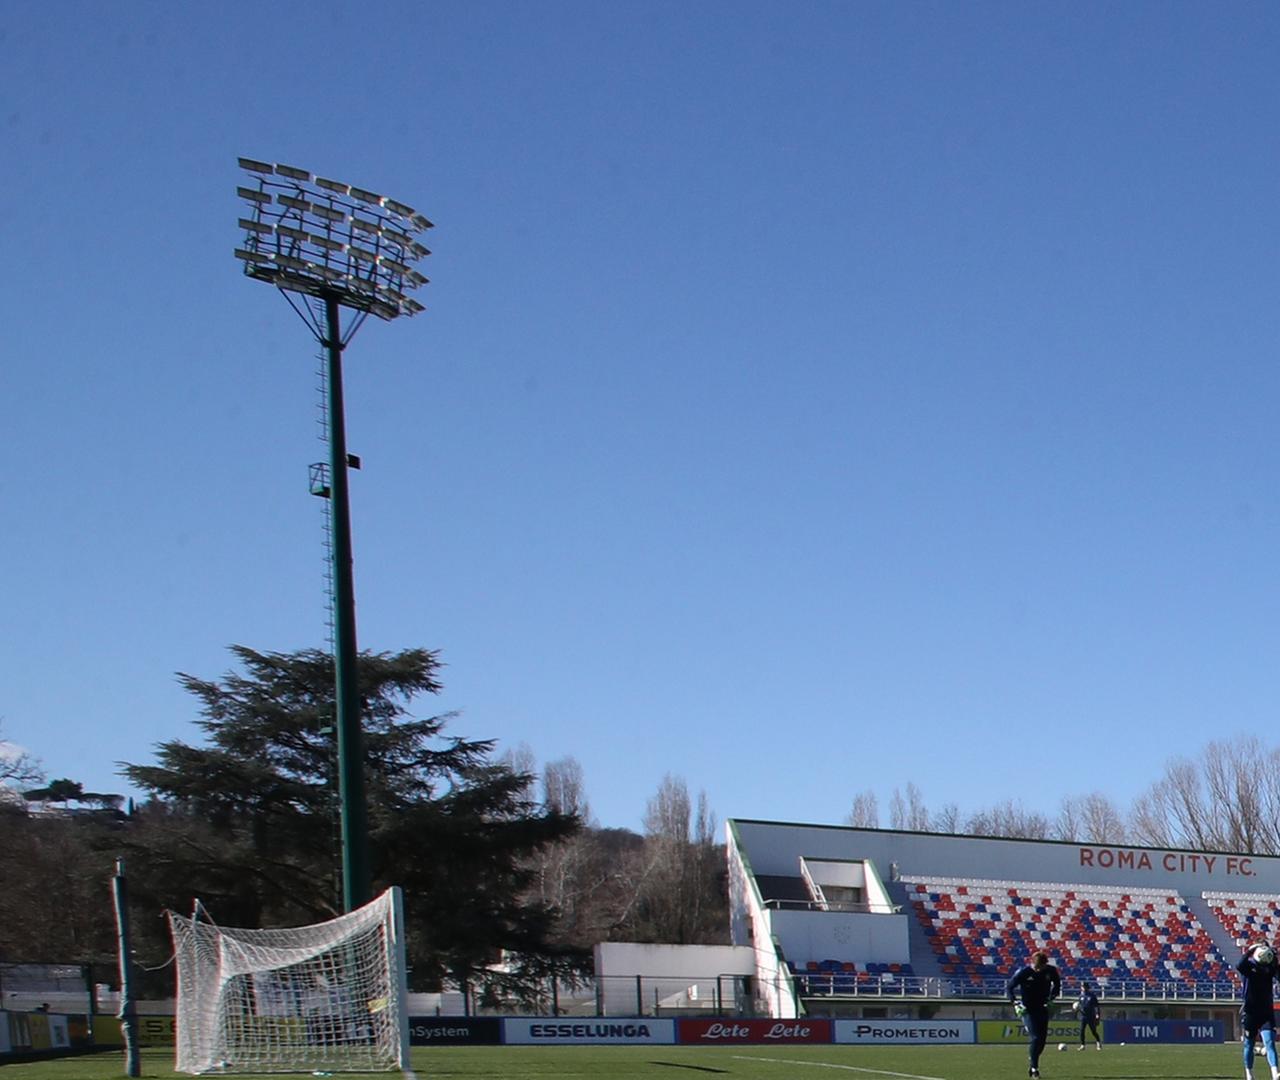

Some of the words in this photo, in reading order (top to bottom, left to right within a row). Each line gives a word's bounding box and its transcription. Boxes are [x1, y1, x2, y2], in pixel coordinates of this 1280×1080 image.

[1079, 847, 1152, 870] ROMA
[1163, 853, 1217, 874] CITY
[1226, 857, 1257, 877] F.C.
[530, 1024, 651, 1038] ESSELUNGA
[701, 1023, 749, 1039] Lete
[763, 1023, 811, 1039] Lete
[853, 1025, 960, 1039] PROMETEON
[1132, 1025, 1158, 1037] TIM
[1189, 1025, 1214, 1037] TIM
